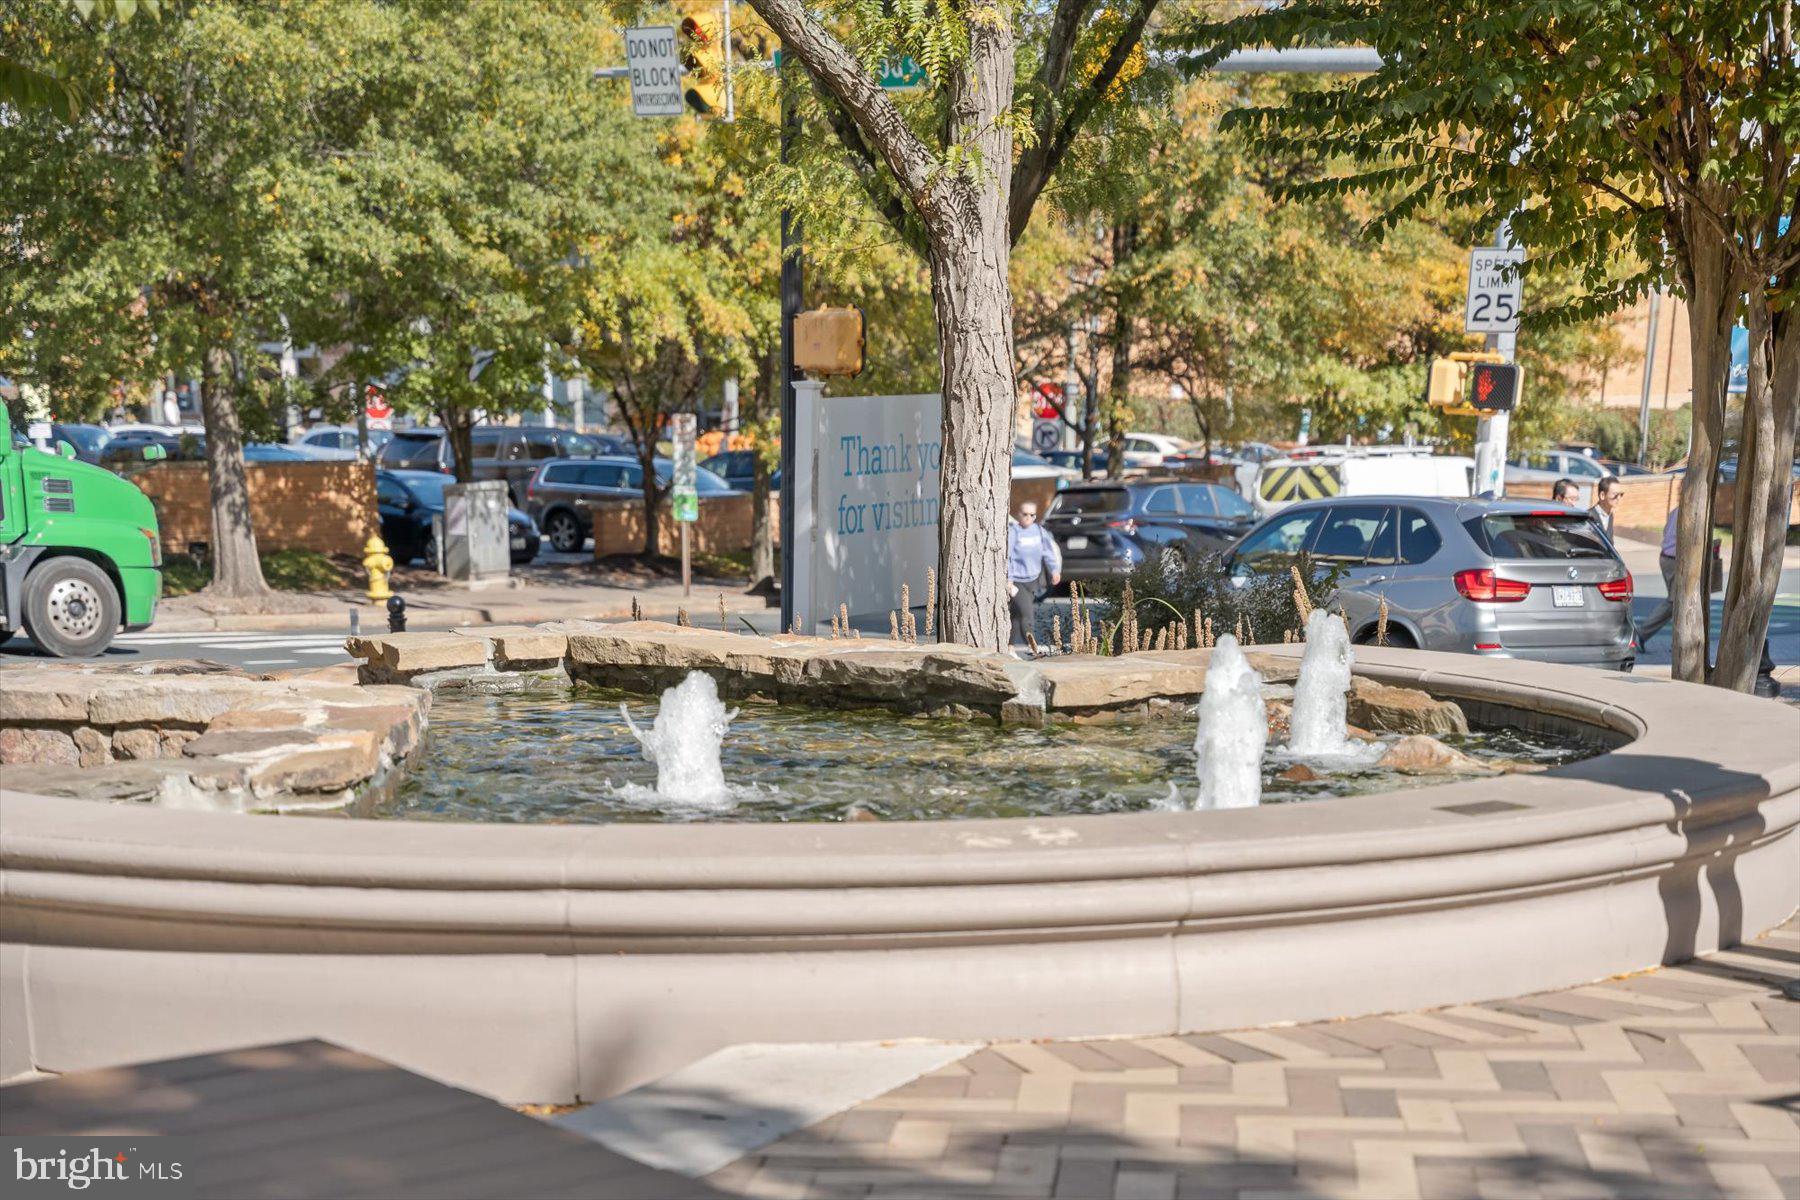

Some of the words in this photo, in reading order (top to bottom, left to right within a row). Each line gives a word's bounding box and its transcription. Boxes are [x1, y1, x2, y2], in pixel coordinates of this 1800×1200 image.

[629, 40, 647, 58] DO
[648, 38, 674, 58] NOT
[633, 67, 678, 87] BLOCK
[1475, 258, 1519, 271] SPEE
[1472, 293, 1513, 323] 25
[841, 433, 912, 477] Thank
[917, 442, 941, 480] yo
[838, 494, 866, 535] for
[872, 491, 940, 531] visitin
